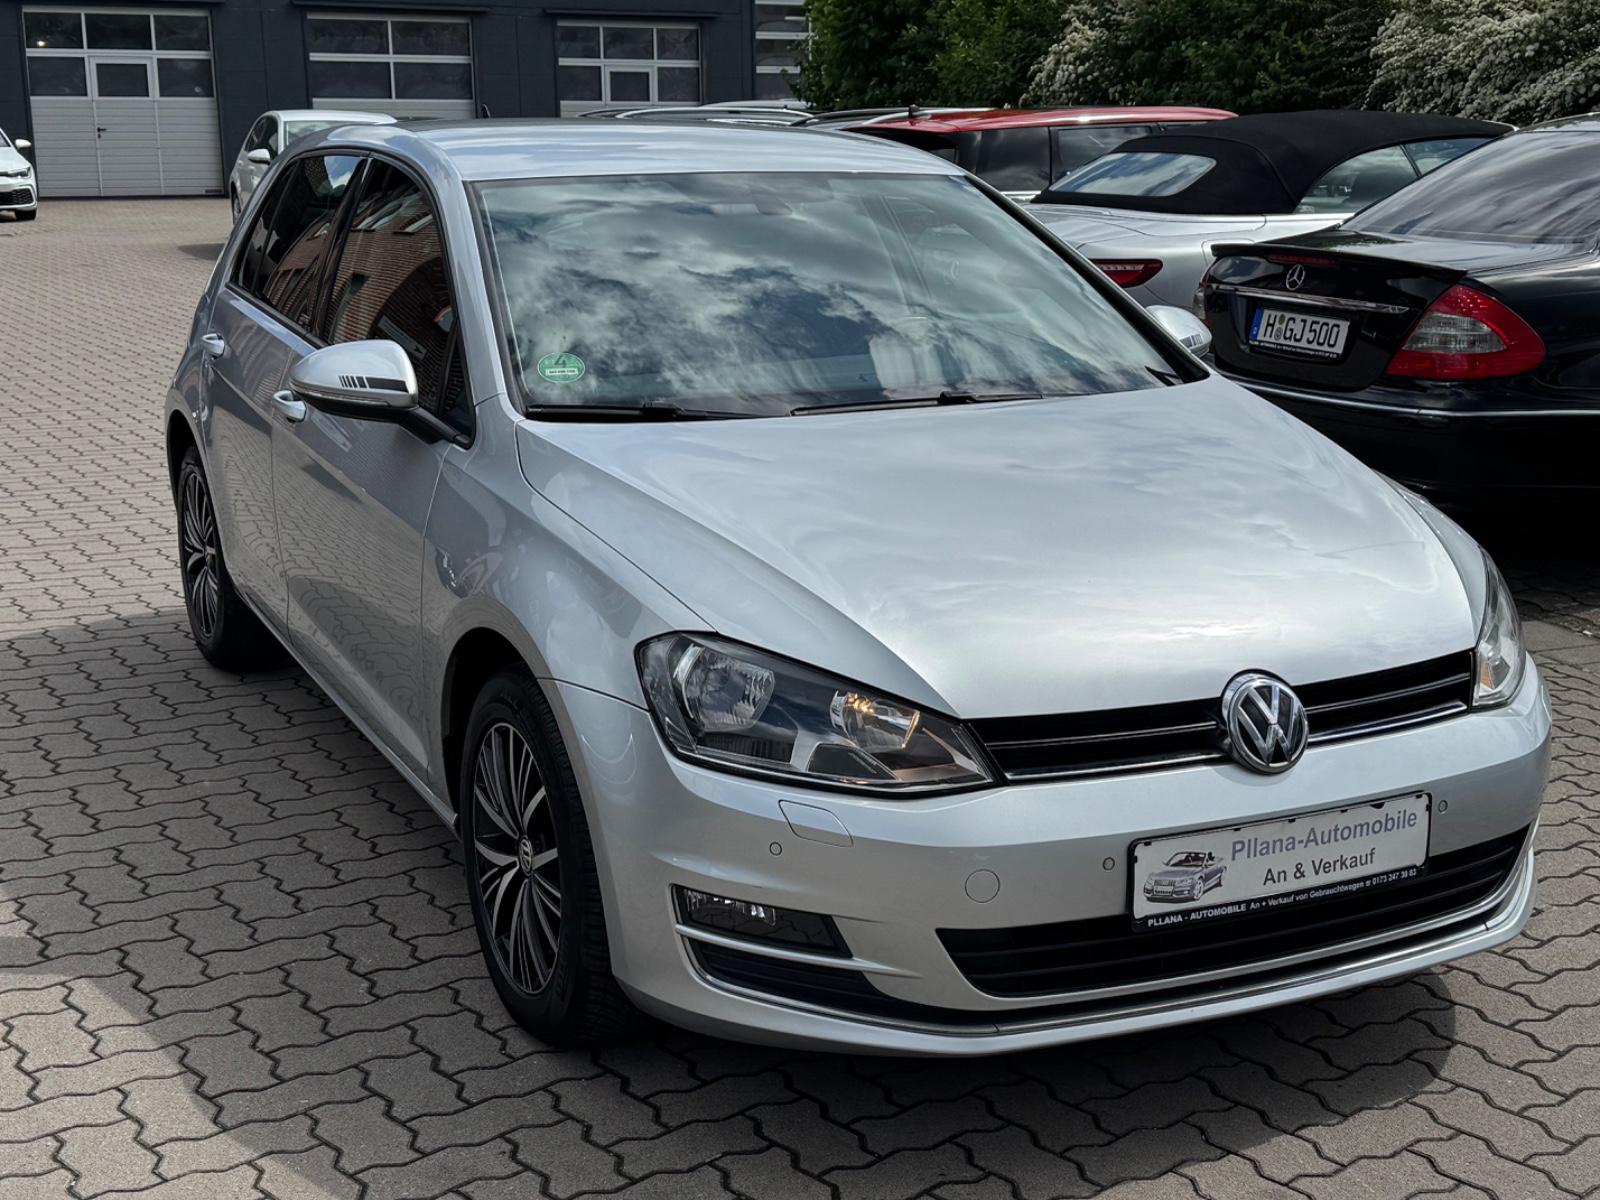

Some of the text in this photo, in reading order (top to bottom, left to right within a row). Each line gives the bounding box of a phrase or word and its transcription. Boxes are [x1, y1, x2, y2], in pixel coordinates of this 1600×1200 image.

[1263, 314, 1278, 338] H
[554, 355, 568, 368] 4
[1231, 811, 1417, 862] Pllana-Automobile
[1263, 848, 1376, 886] An & Verkauf
[1147, 914, 1183, 927] PLLANA
[1190, 903, 1247, 920] AUTOMOBILE
[1249, 901, 1260, 910] An
[1268, 894, 1294, 907] Verkauf
[1295, 892, 1309, 900] von
[1309, 881, 1365, 898] Gebrauchtwagen
